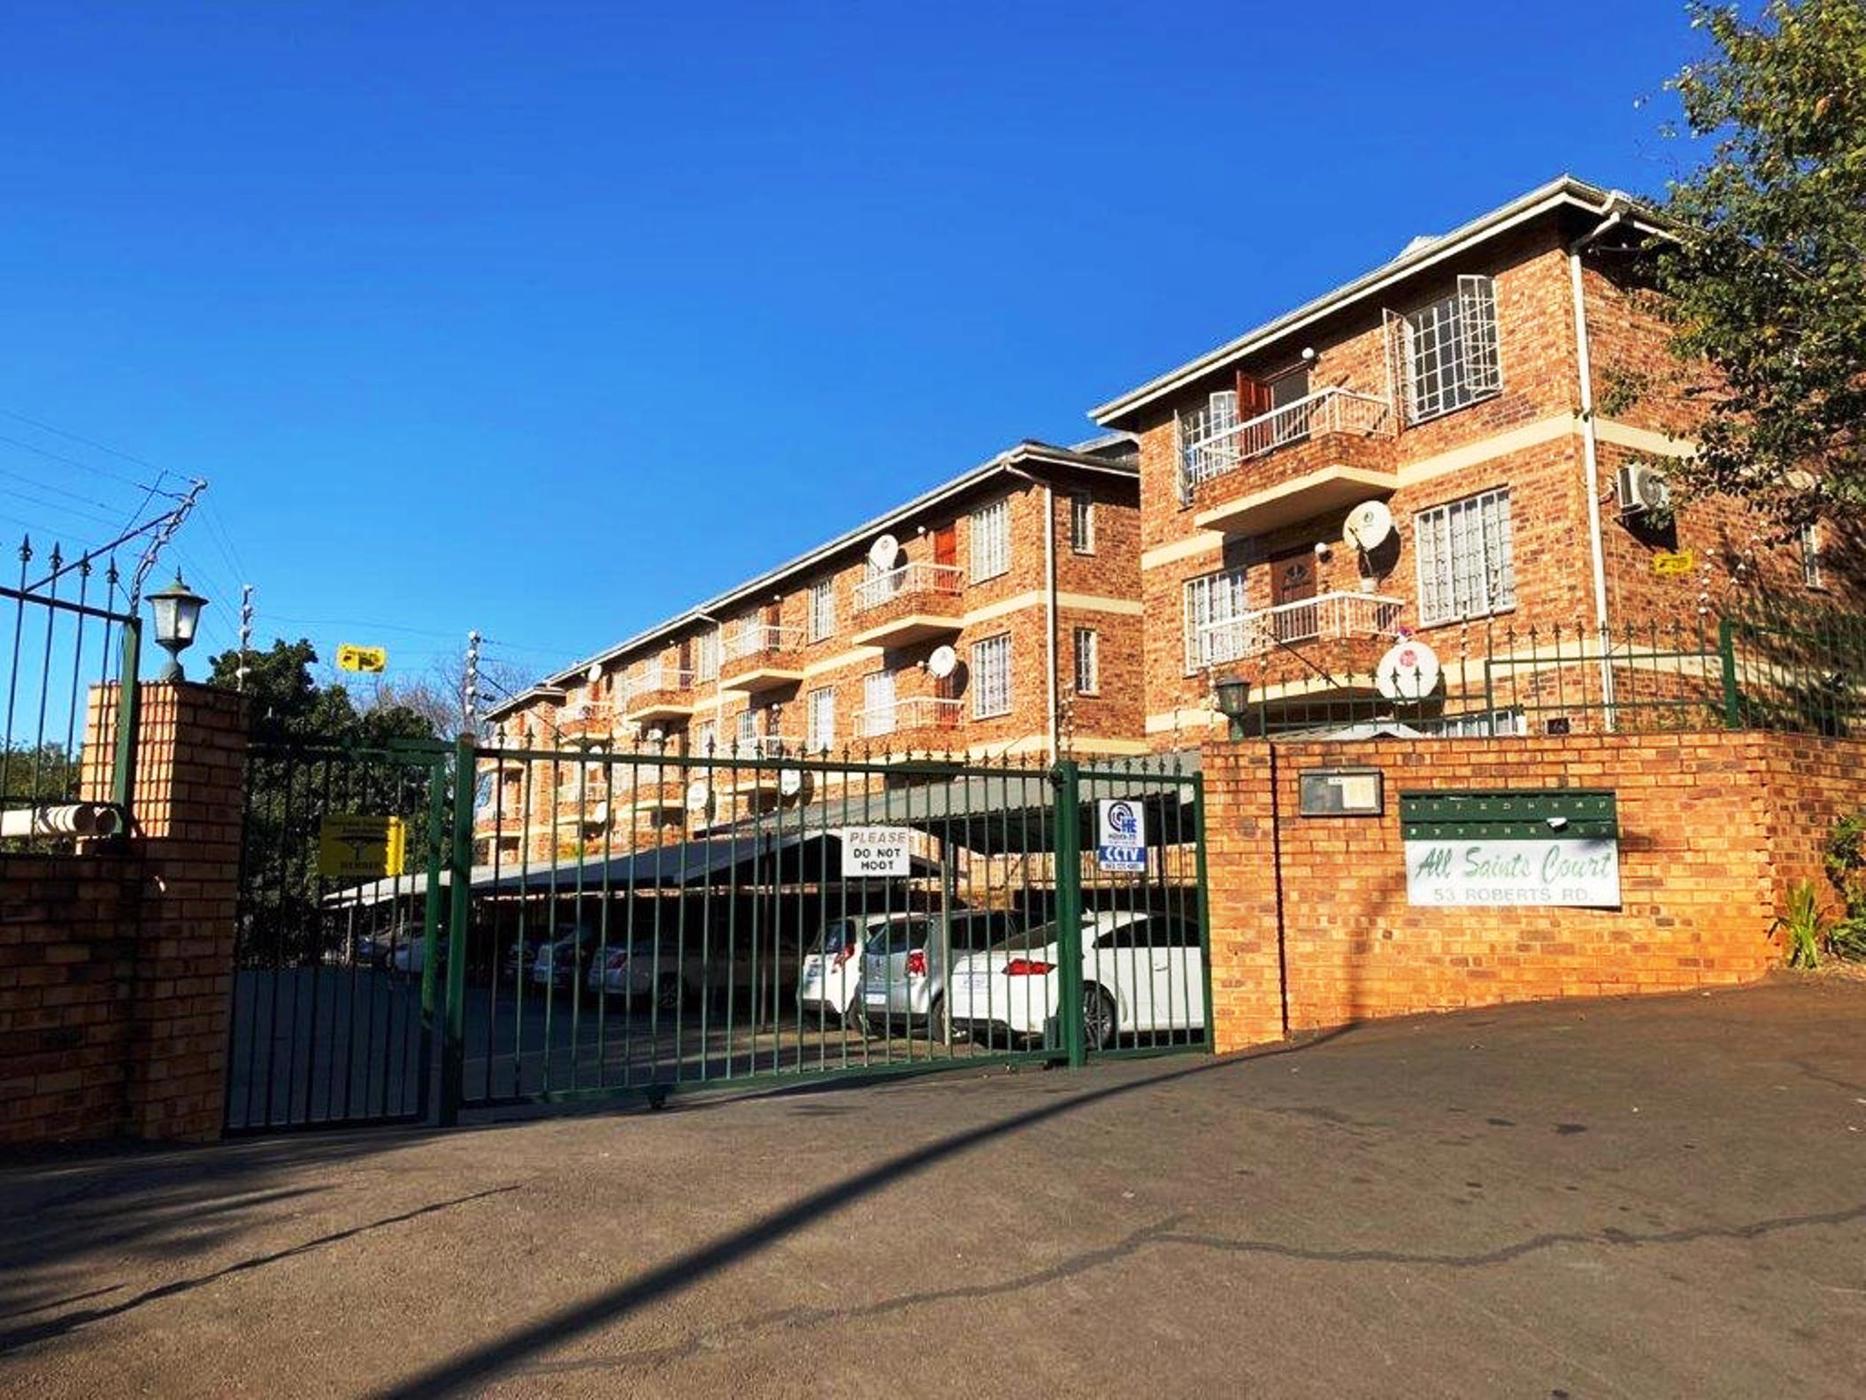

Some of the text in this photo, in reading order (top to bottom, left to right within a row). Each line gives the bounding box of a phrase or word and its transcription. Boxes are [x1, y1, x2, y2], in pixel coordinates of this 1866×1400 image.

[850, 832, 907, 843] PLEASE
[853, 848, 901, 859] DO NOT
[1105, 847, 1139, 861] CCTV
[1415, 845, 1611, 884] All Saints Court
[1433, 888, 1456, 901] 53
[1465, 888, 1552, 901] ROBERTS
